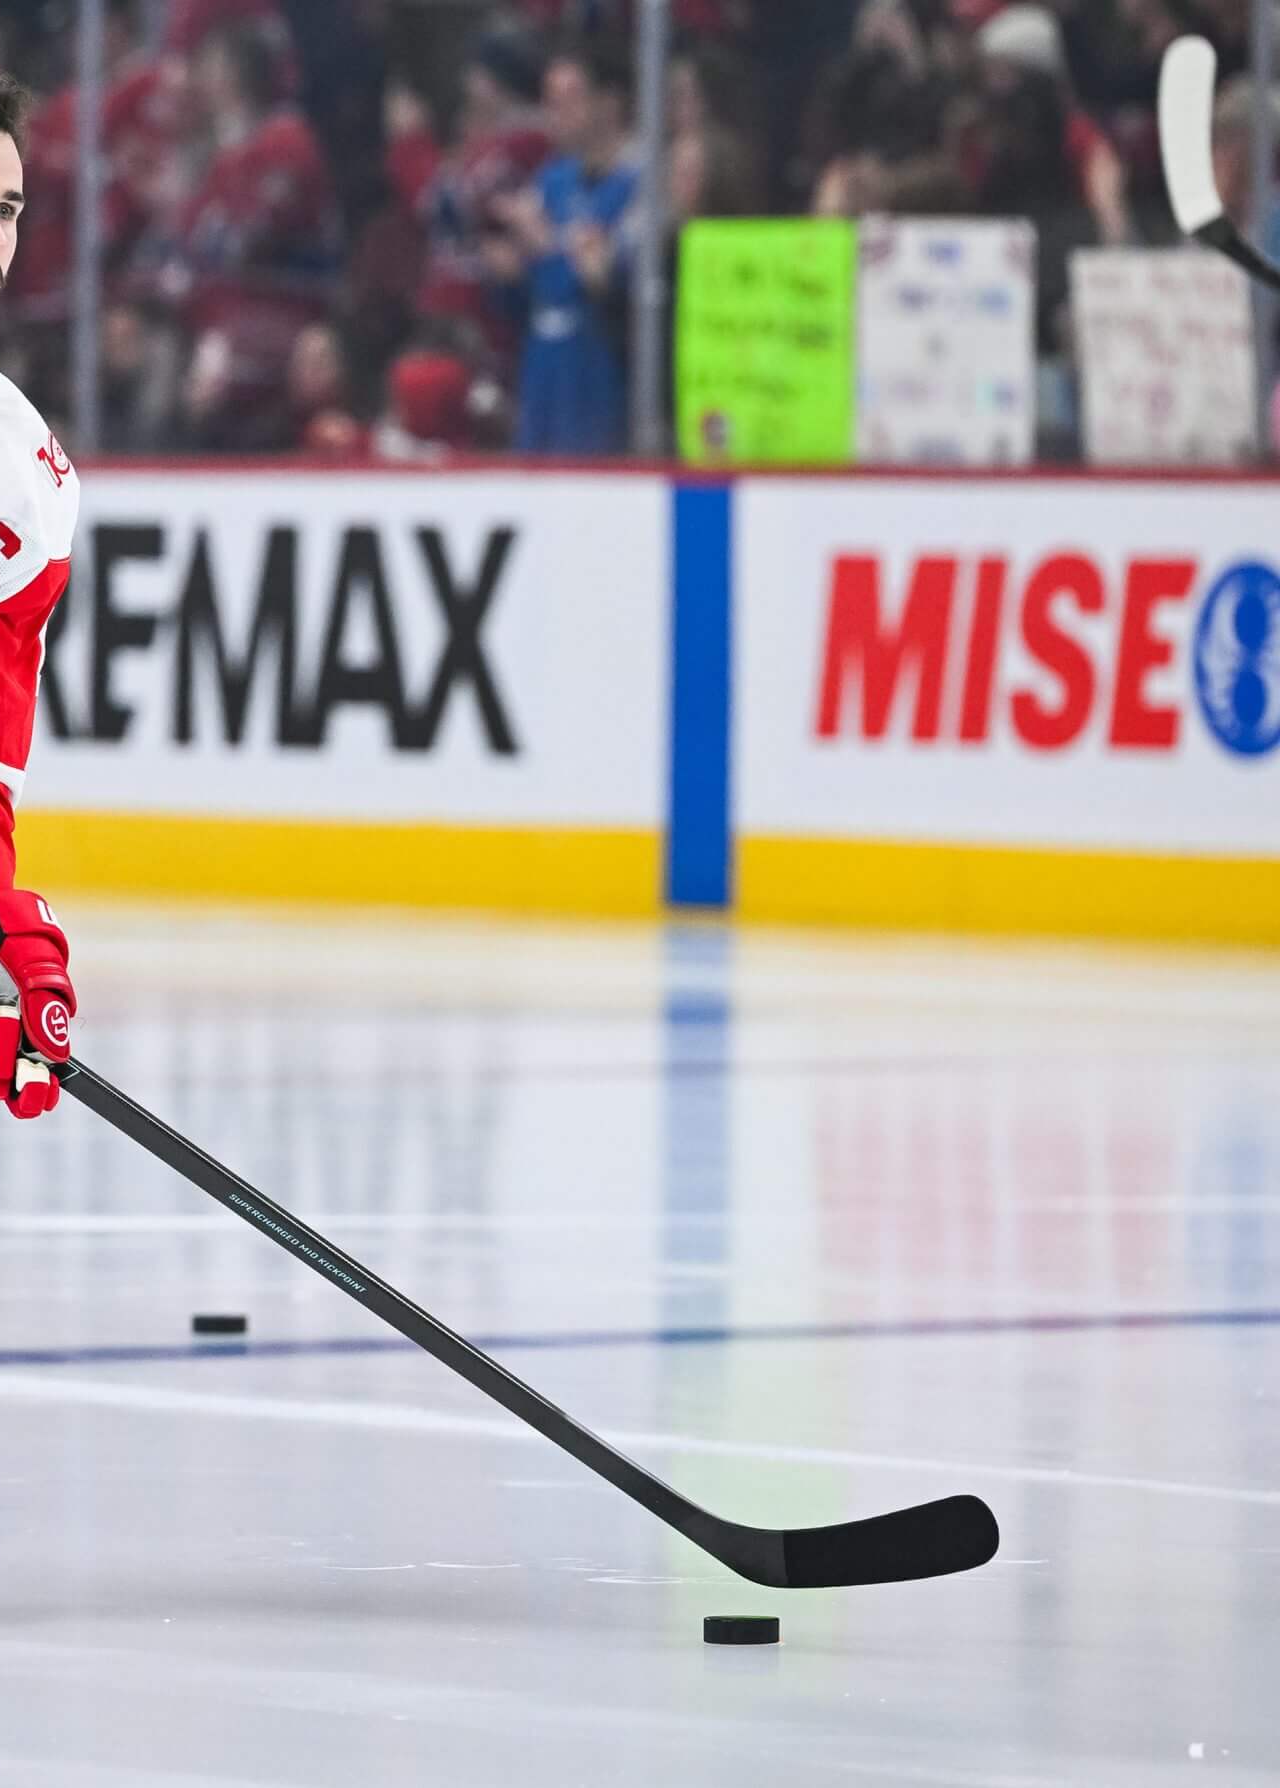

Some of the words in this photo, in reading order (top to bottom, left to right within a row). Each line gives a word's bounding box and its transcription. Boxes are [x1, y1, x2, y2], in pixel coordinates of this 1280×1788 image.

[229, 1193, 300, 1246] SUPERCHARGED
[298, 1243, 319, 1260] MID
[318, 1257, 368, 1294] KICKPOINT
